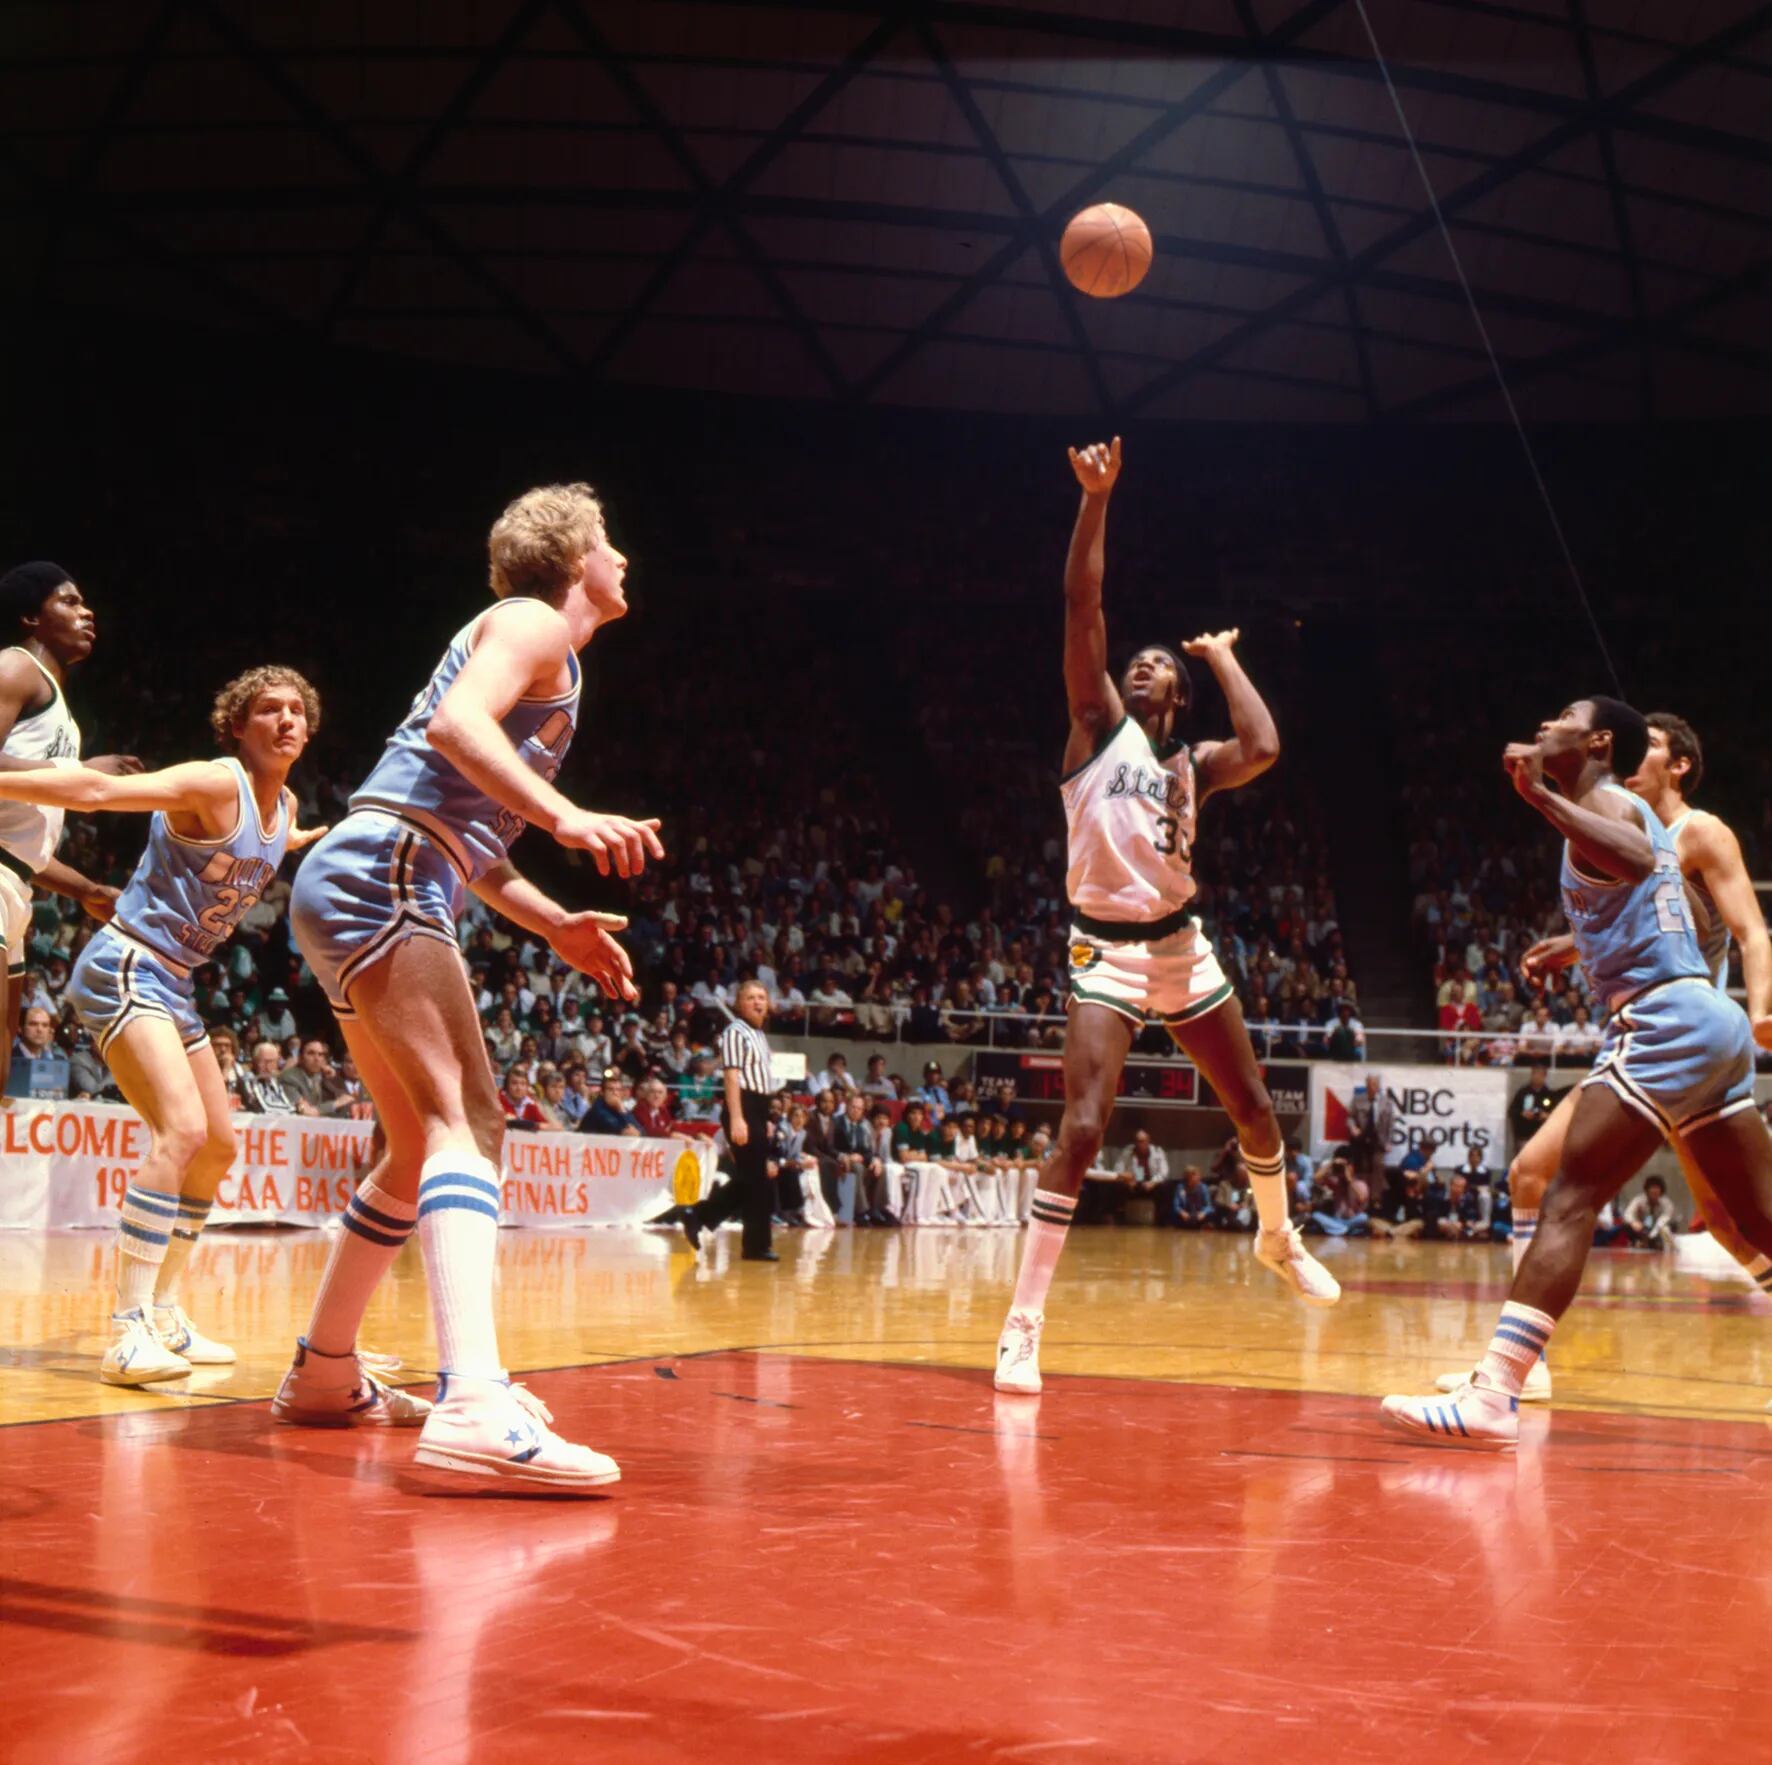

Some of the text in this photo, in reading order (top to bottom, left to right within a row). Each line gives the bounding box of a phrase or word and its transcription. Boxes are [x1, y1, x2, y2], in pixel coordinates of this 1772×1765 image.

[981, 1076, 1016, 1087] TEAM
[1271, 1088, 1305, 1100] TEAM
[1387, 1086, 1455, 1117] NBC
[1391, 1118, 1490, 1151] Sports
[300, 1131, 371, 1169] UNIV
[508, 1142, 571, 1177] UTAH
[581, 1146, 620, 1177] AND
[630, 1150, 665, 1178] THE
[502, 1179, 589, 1215] FINALS
